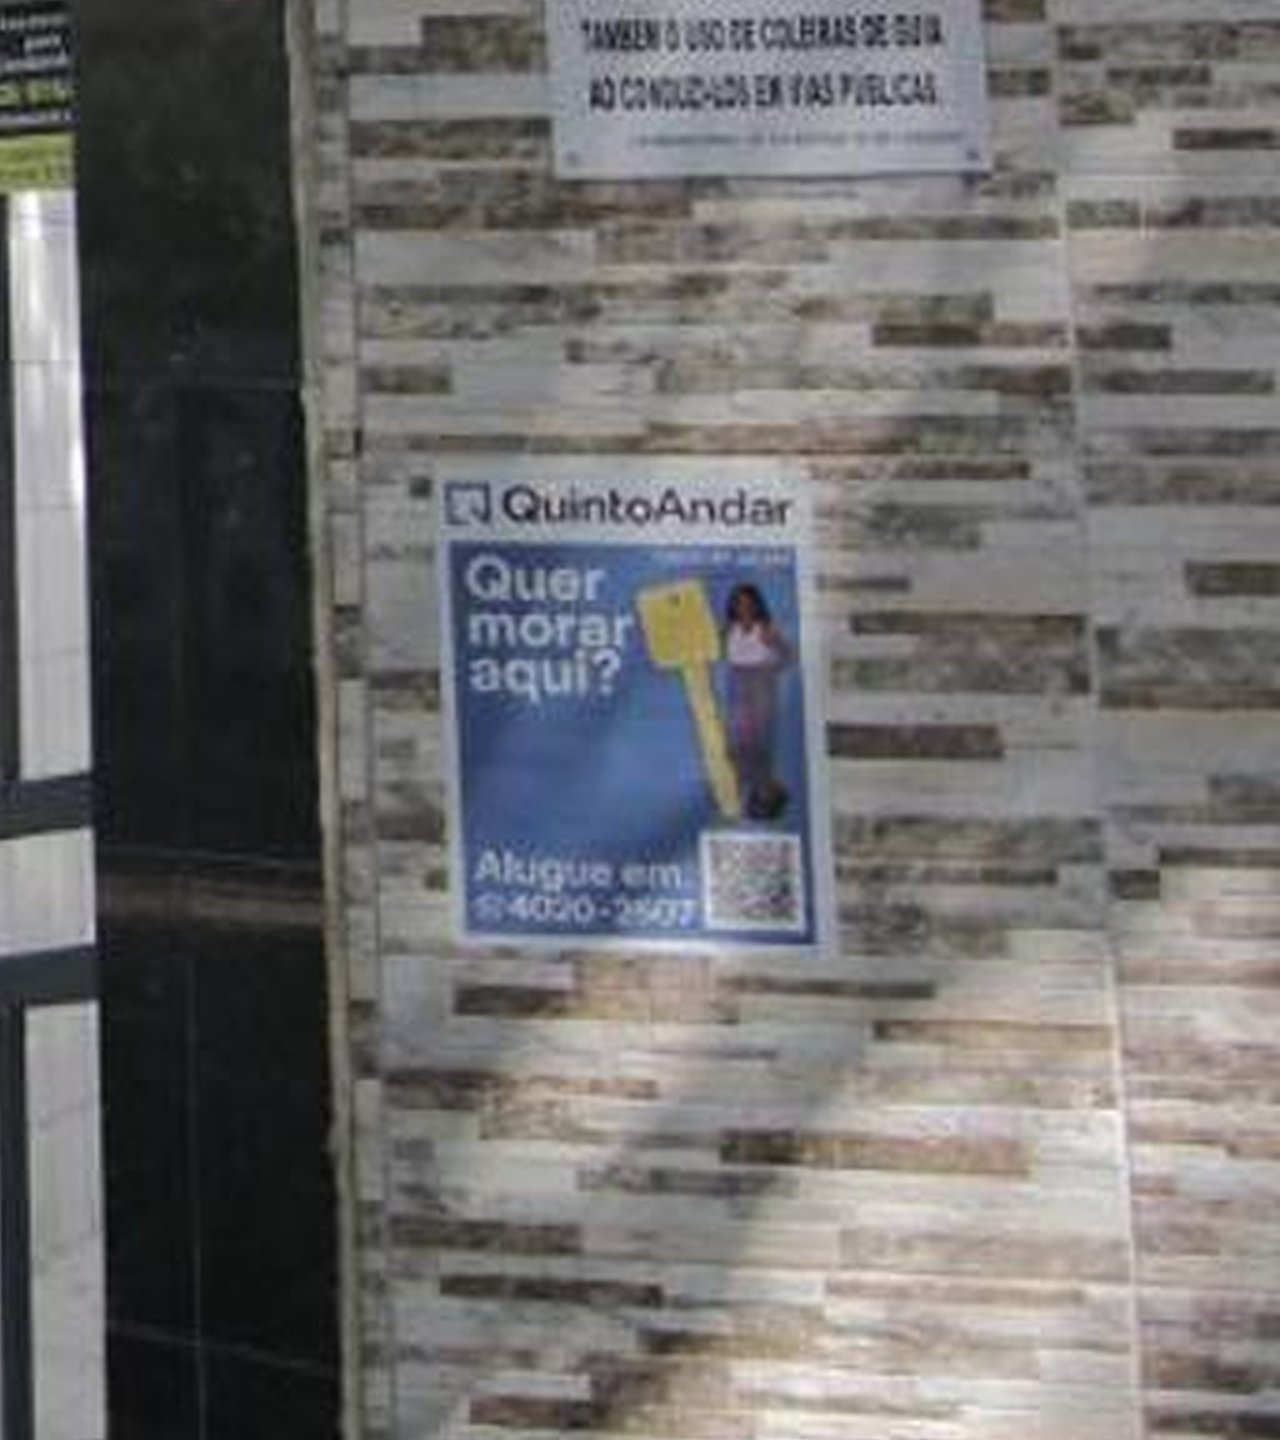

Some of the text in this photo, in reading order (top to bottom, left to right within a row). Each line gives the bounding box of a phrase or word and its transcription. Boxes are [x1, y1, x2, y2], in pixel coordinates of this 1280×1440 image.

[501, 486, 793, 528] QuintoAndar
[465, 555, 606, 602] Quer
[469, 610, 633, 649] morar
[468, 650, 621, 702] aqui?
[474, 850, 683, 891] Alugue em
